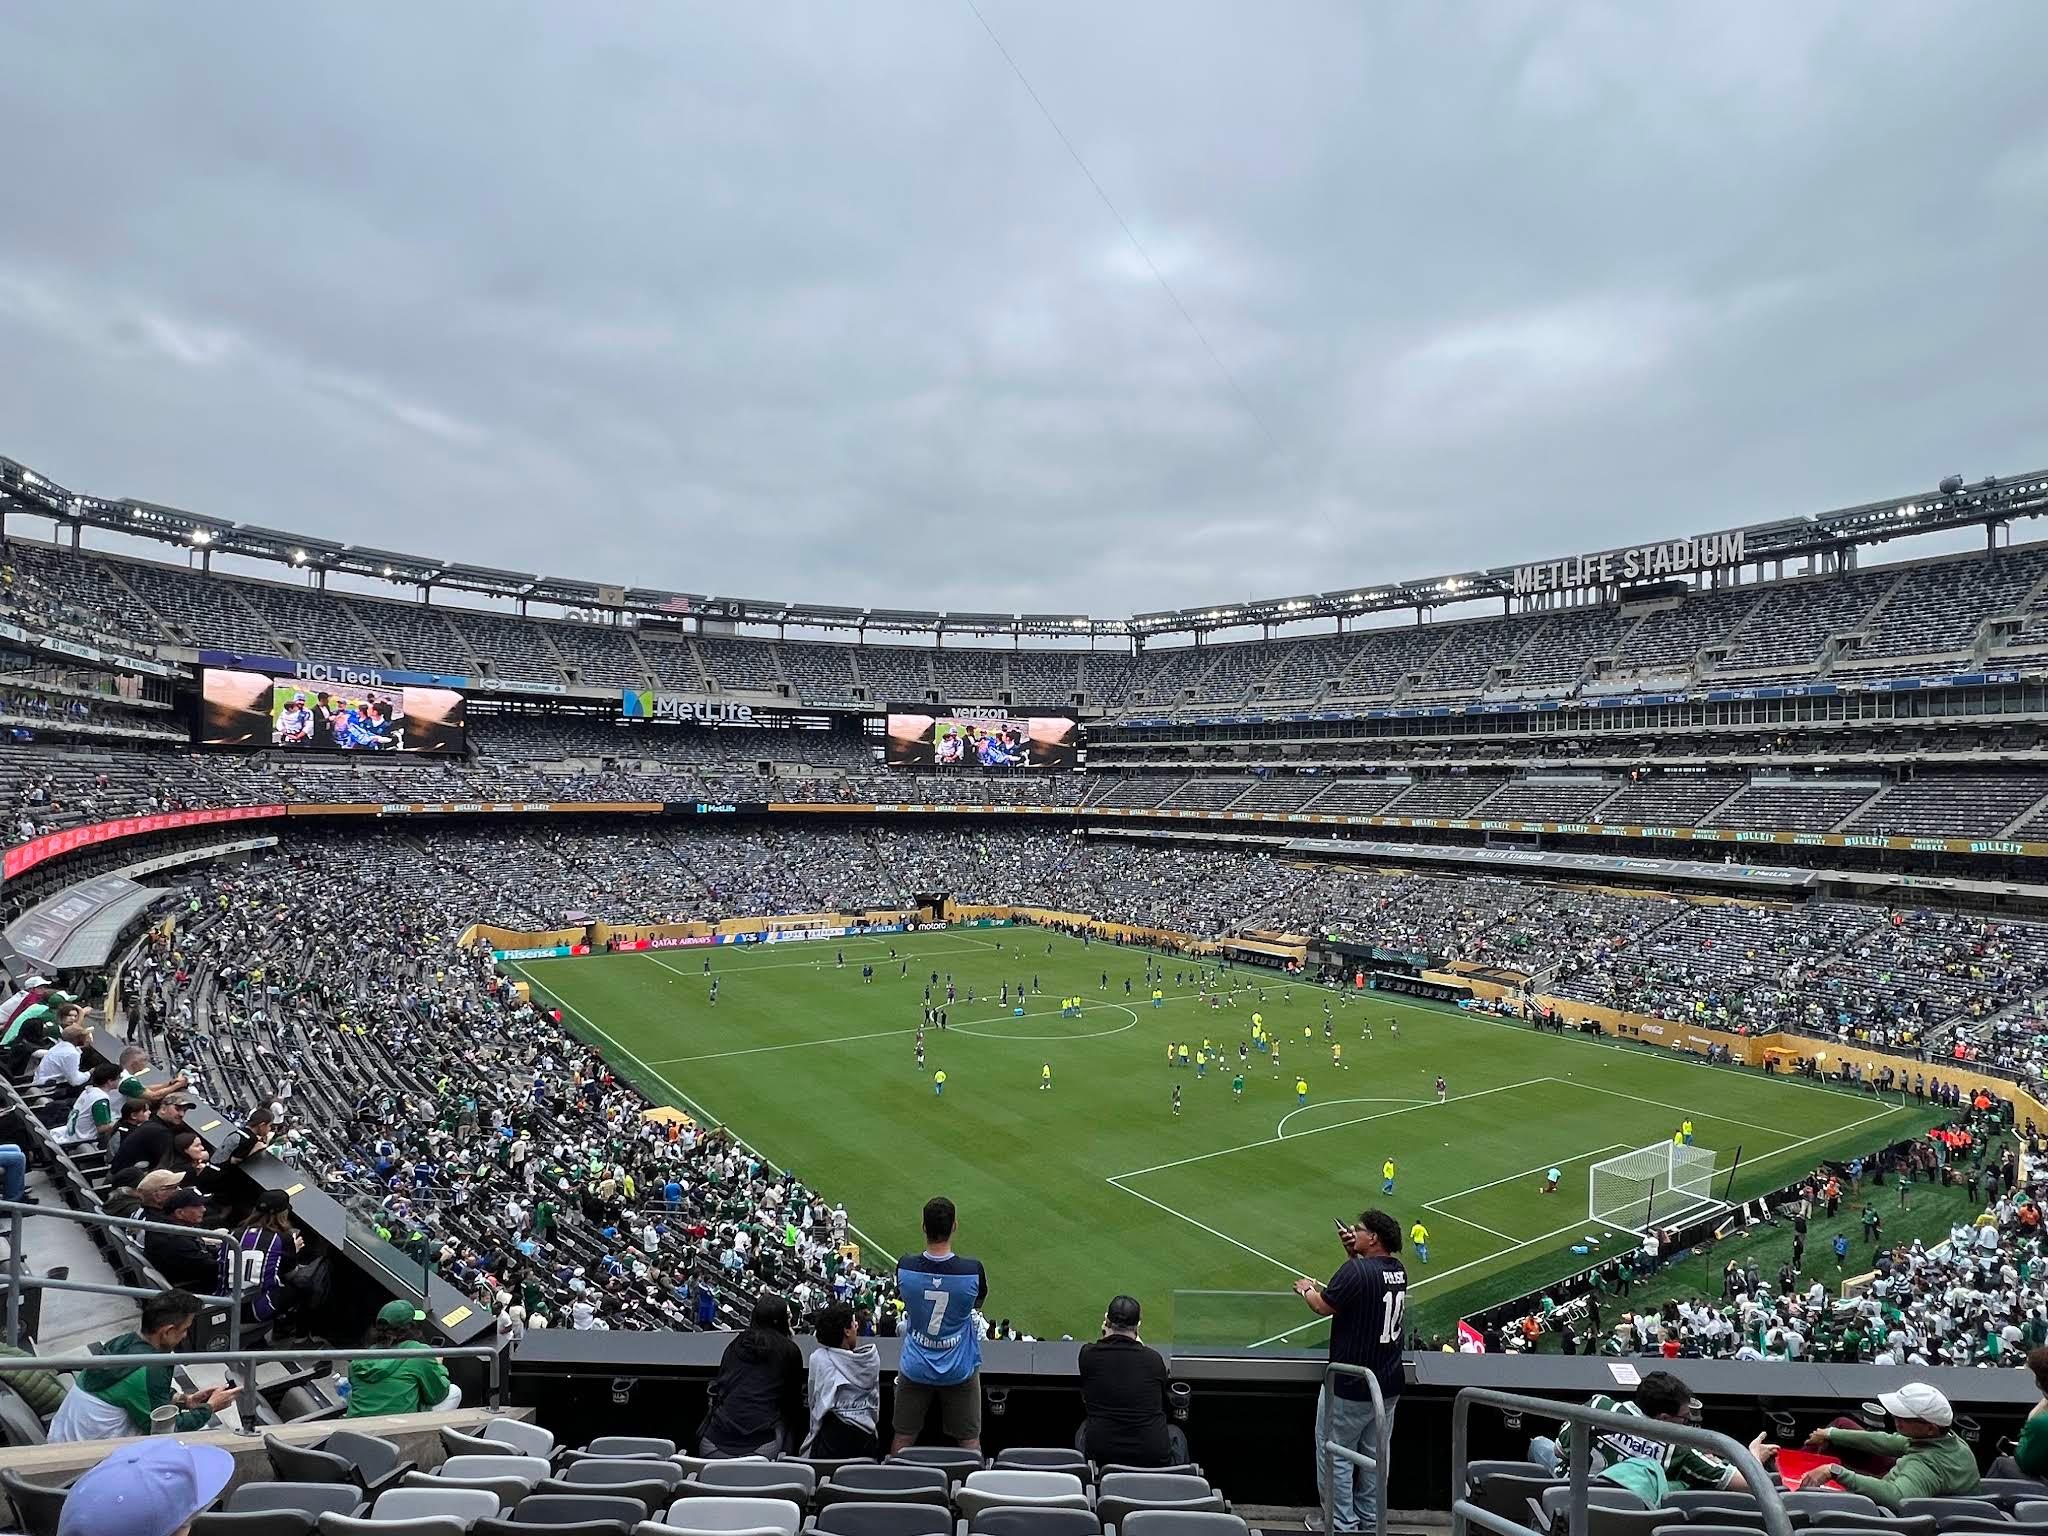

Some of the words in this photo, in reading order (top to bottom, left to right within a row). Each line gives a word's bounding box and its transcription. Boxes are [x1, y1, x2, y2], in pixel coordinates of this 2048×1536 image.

[1513, 553, 1615, 595] METLIFE
[1622, 530, 1745, 580] STADIUM
[296, 662, 382, 687] HCLTech
[656, 696, 752, 721] MetLife
[951, 706, 1008, 720] verizon
[708, 804, 736, 812] MetLife
[1411, 819, 1438, 828] BULLEIT
[1481, 820, 1510, 830] BULLEIT
[1557, 824, 1589, 833] BULLEIT
[1642, 827, 1678, 838] BULLEIT
[1736, 831, 1777, 843] BULLEIT
[1793, 838, 1827, 846] WHISKEY
[1844, 835, 1890, 848] BULLEIT
[1910, 843, 1949, 851] WHISKEY
[1970, 841, 2025, 855] BULLEIT
[1475, 851, 1507, 859] METLIFE
[1508, 853, 1545, 861] STADIUM
[1754, 869, 1792, 878] MetLife
[876, 925, 897, 933] ULTRA
[651, 939, 678, 948] QATAR
[679, 936, 711, 945] AIRWAYS
[504, 947, 557, 960] Hisense
[227, 1249, 265, 1290] 10
[924, 1289, 950, 1336] 7
[1380, 1290, 1406, 1344] 10
